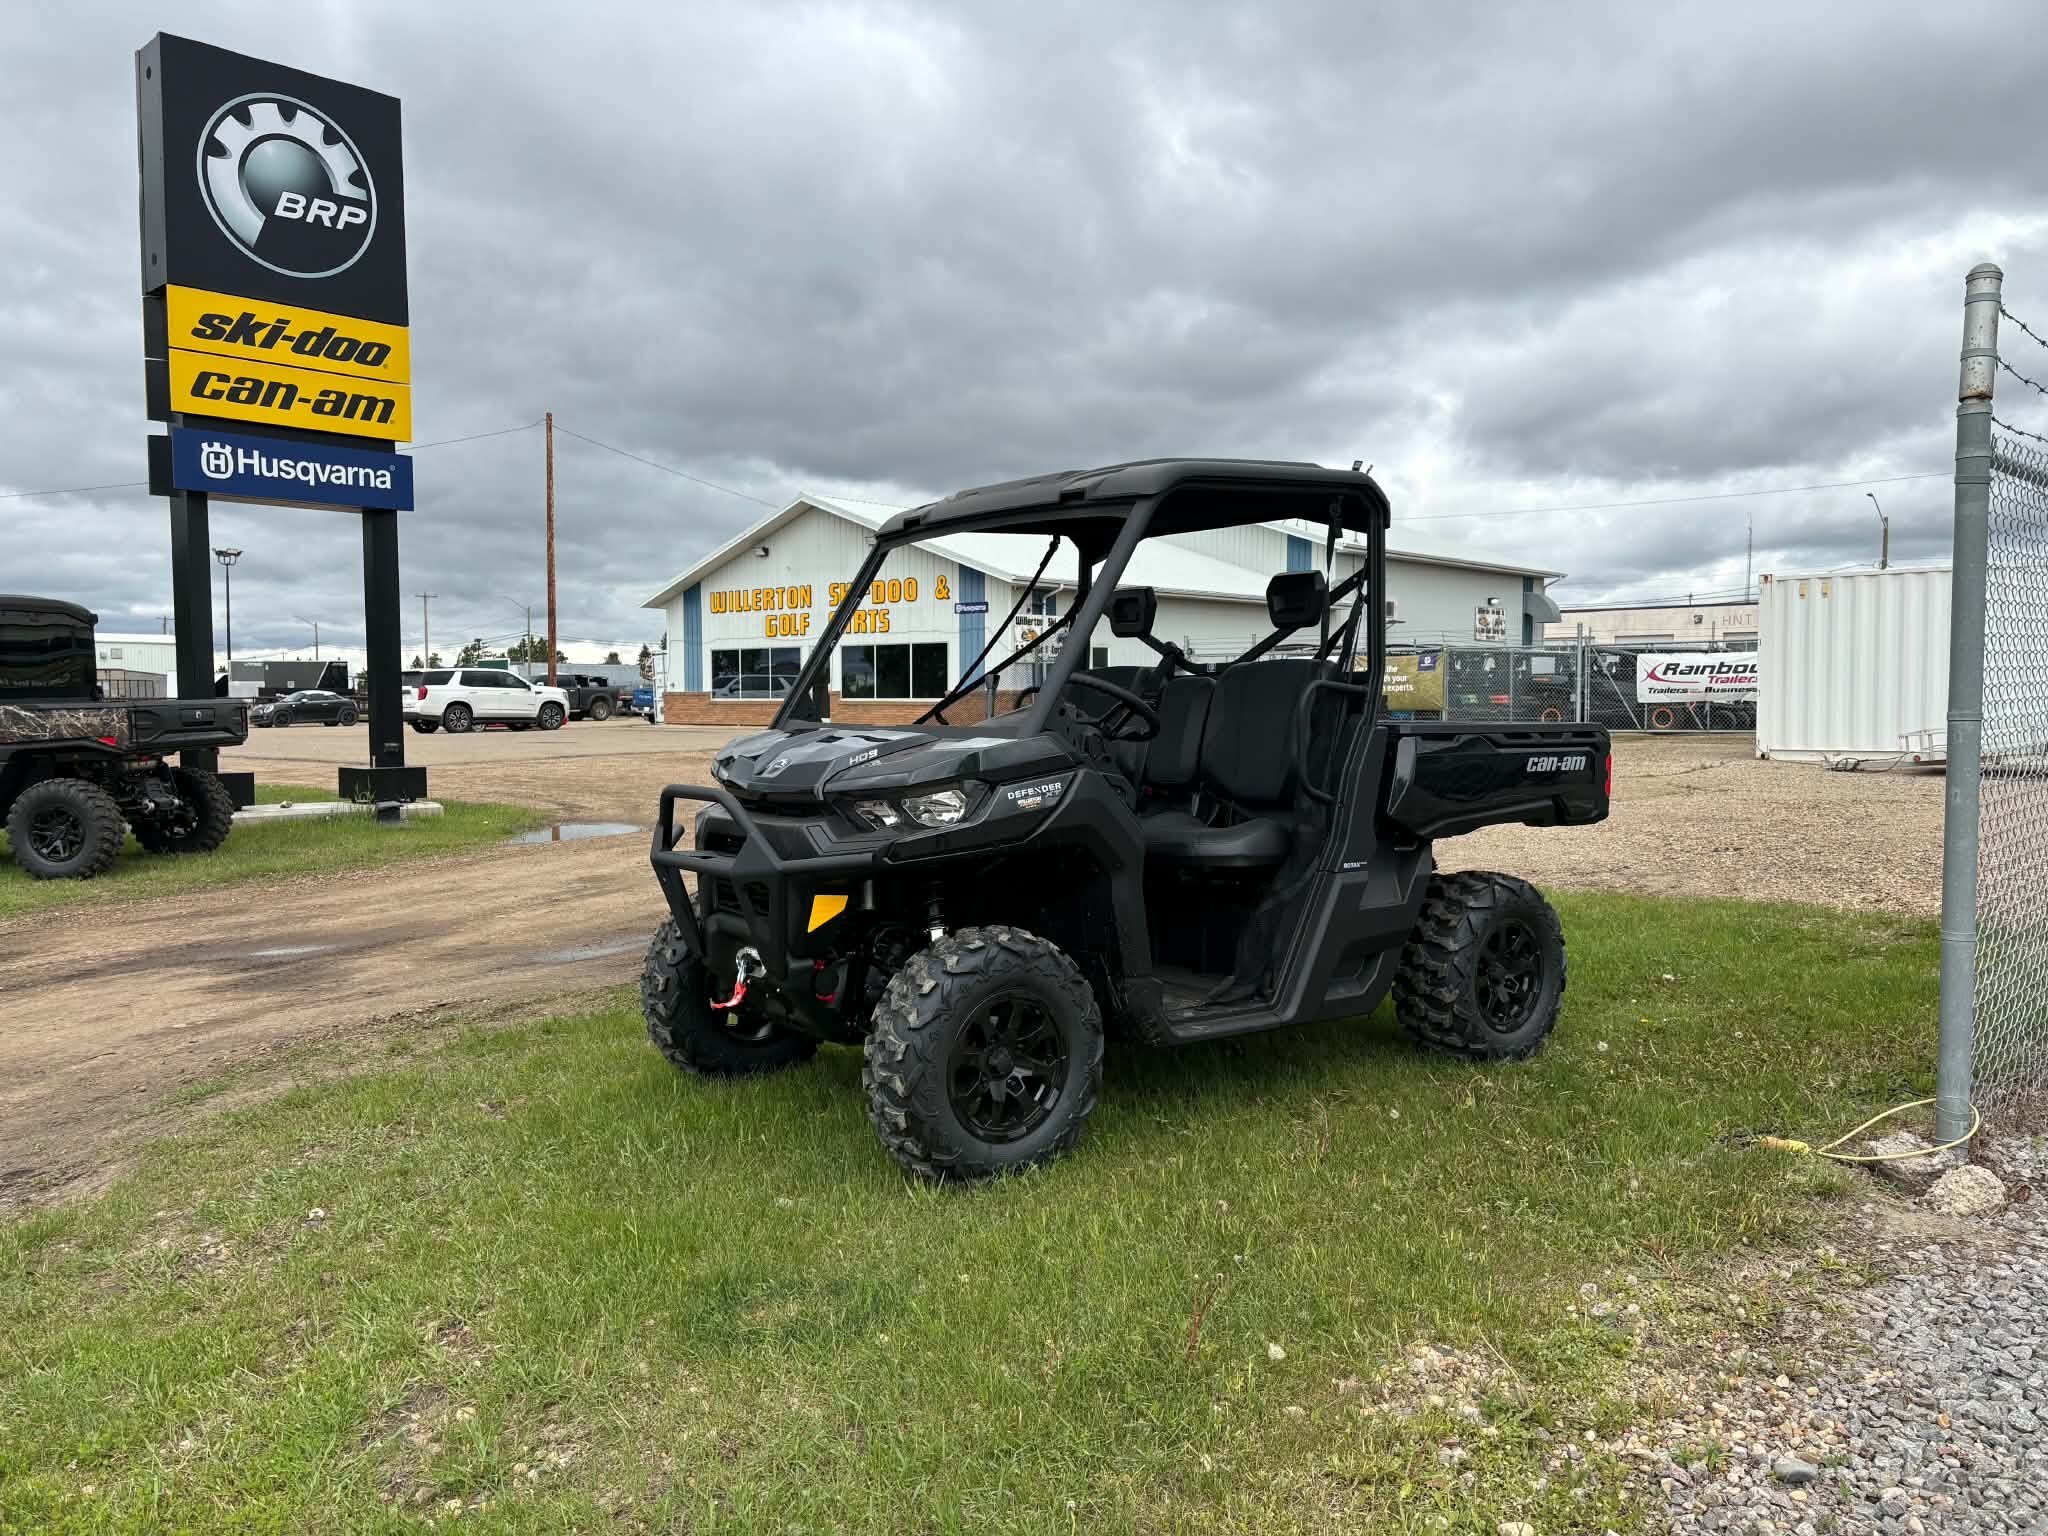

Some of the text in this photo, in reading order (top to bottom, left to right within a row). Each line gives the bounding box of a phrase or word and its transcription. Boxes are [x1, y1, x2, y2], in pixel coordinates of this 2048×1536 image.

[273, 191, 368, 231] BRP
[191, 311, 392, 367] ski-doo
[190, 371, 396, 424] can-am
[237, 448, 393, 489] Husqvarna
[710, 584, 812, 614] WILLERTON
[934, 574, 952, 601] &
[765, 612, 810, 638] GOLF
[1648, 686, 1689, 694] Trailers
[1526, 755, 1587, 772] can-am
[1007, 782, 1062, 800] DEFENDER
